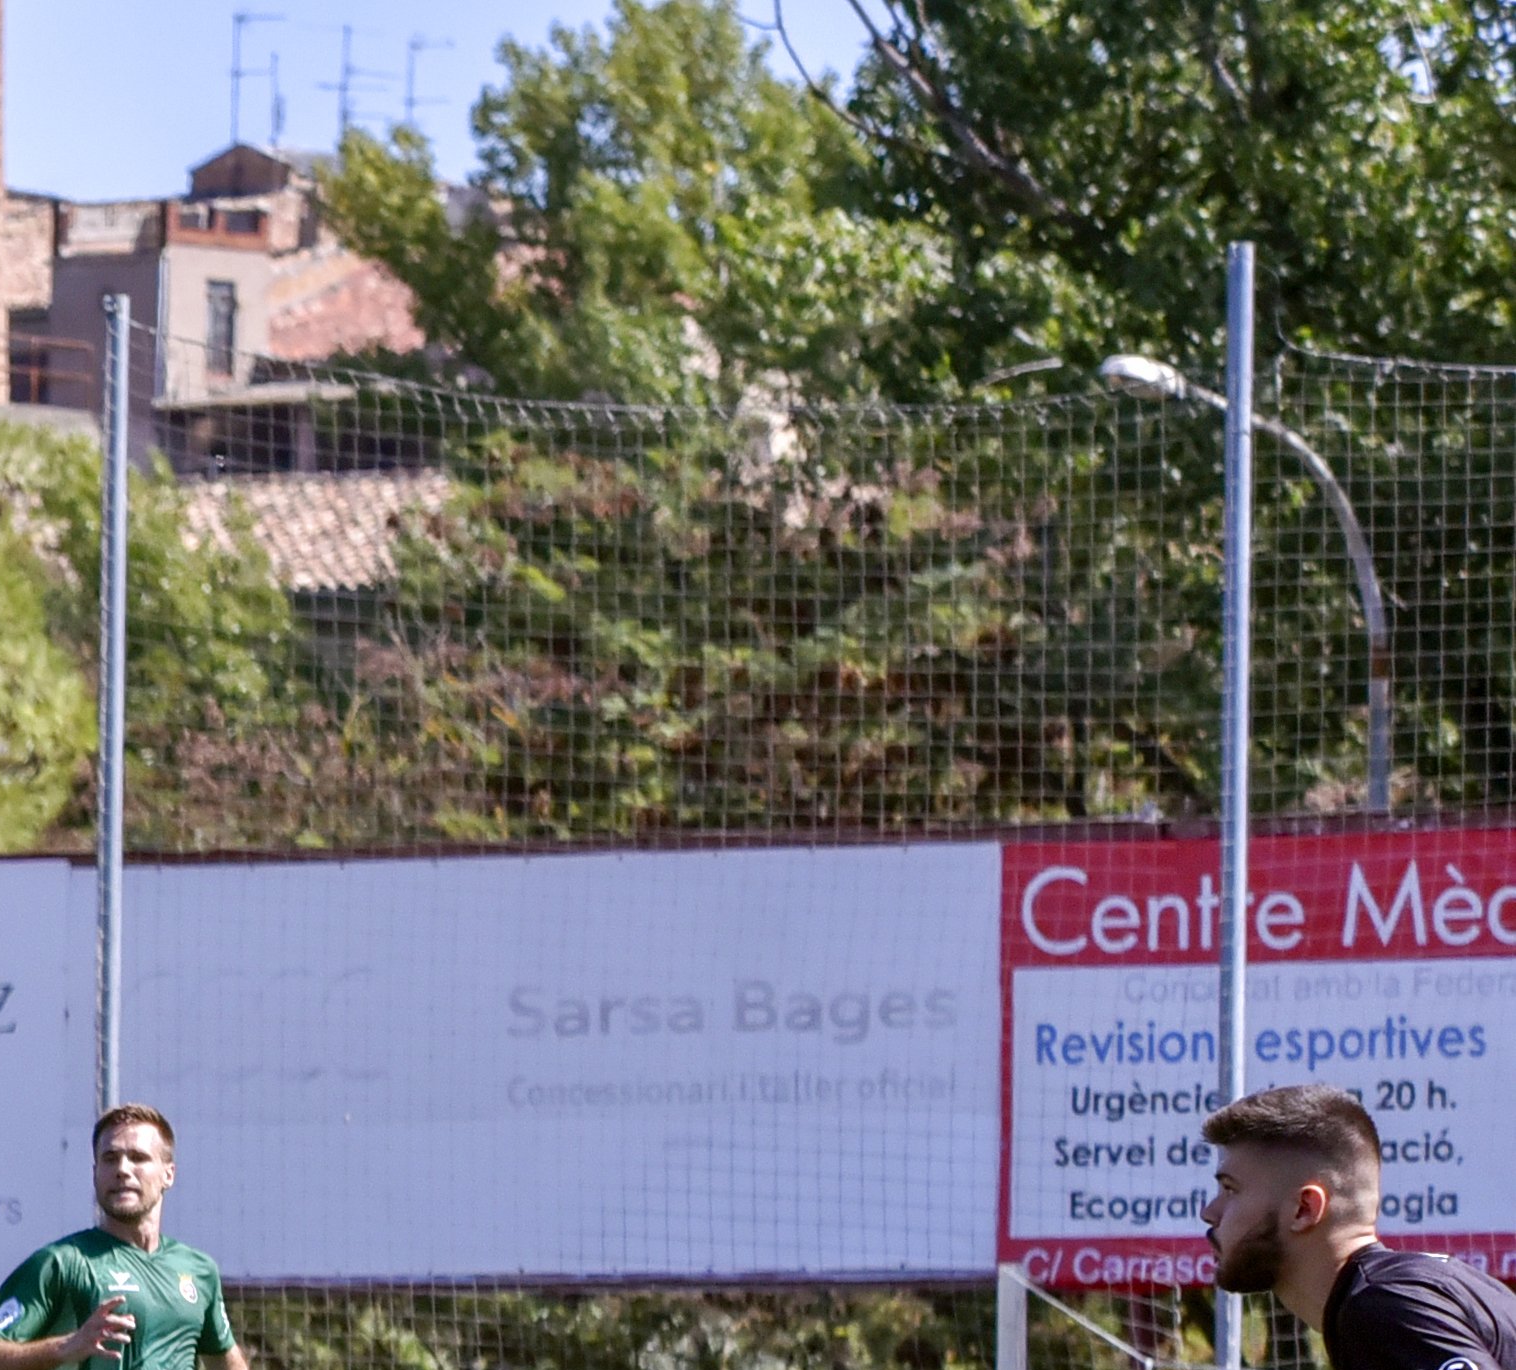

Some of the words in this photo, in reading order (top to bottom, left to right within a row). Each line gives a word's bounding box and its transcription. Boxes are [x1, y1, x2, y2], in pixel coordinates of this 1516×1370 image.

[1021, 865, 1306, 956] Cente
[507, 984, 705, 1038] Sarsa
[732, 978, 958, 1046] Bages
[1036, 1019, 1216, 1064] Revision
[1255, 1015, 1487, 1071] esportives
[1071, 1081, 1222, 1122] Urgèncie
[1375, 1080, 1416, 1111] 20
[1427, 1078, 1457, 1110] h.
[1054, 1135, 1156, 1167] Servei
[1167, 1135, 1212, 1166] de
[1070, 1188, 1208, 1225] Ecografi
[1380, 1184, 1459, 1224] ogia
[1073, 1247, 1216, 1285] Carrasc
